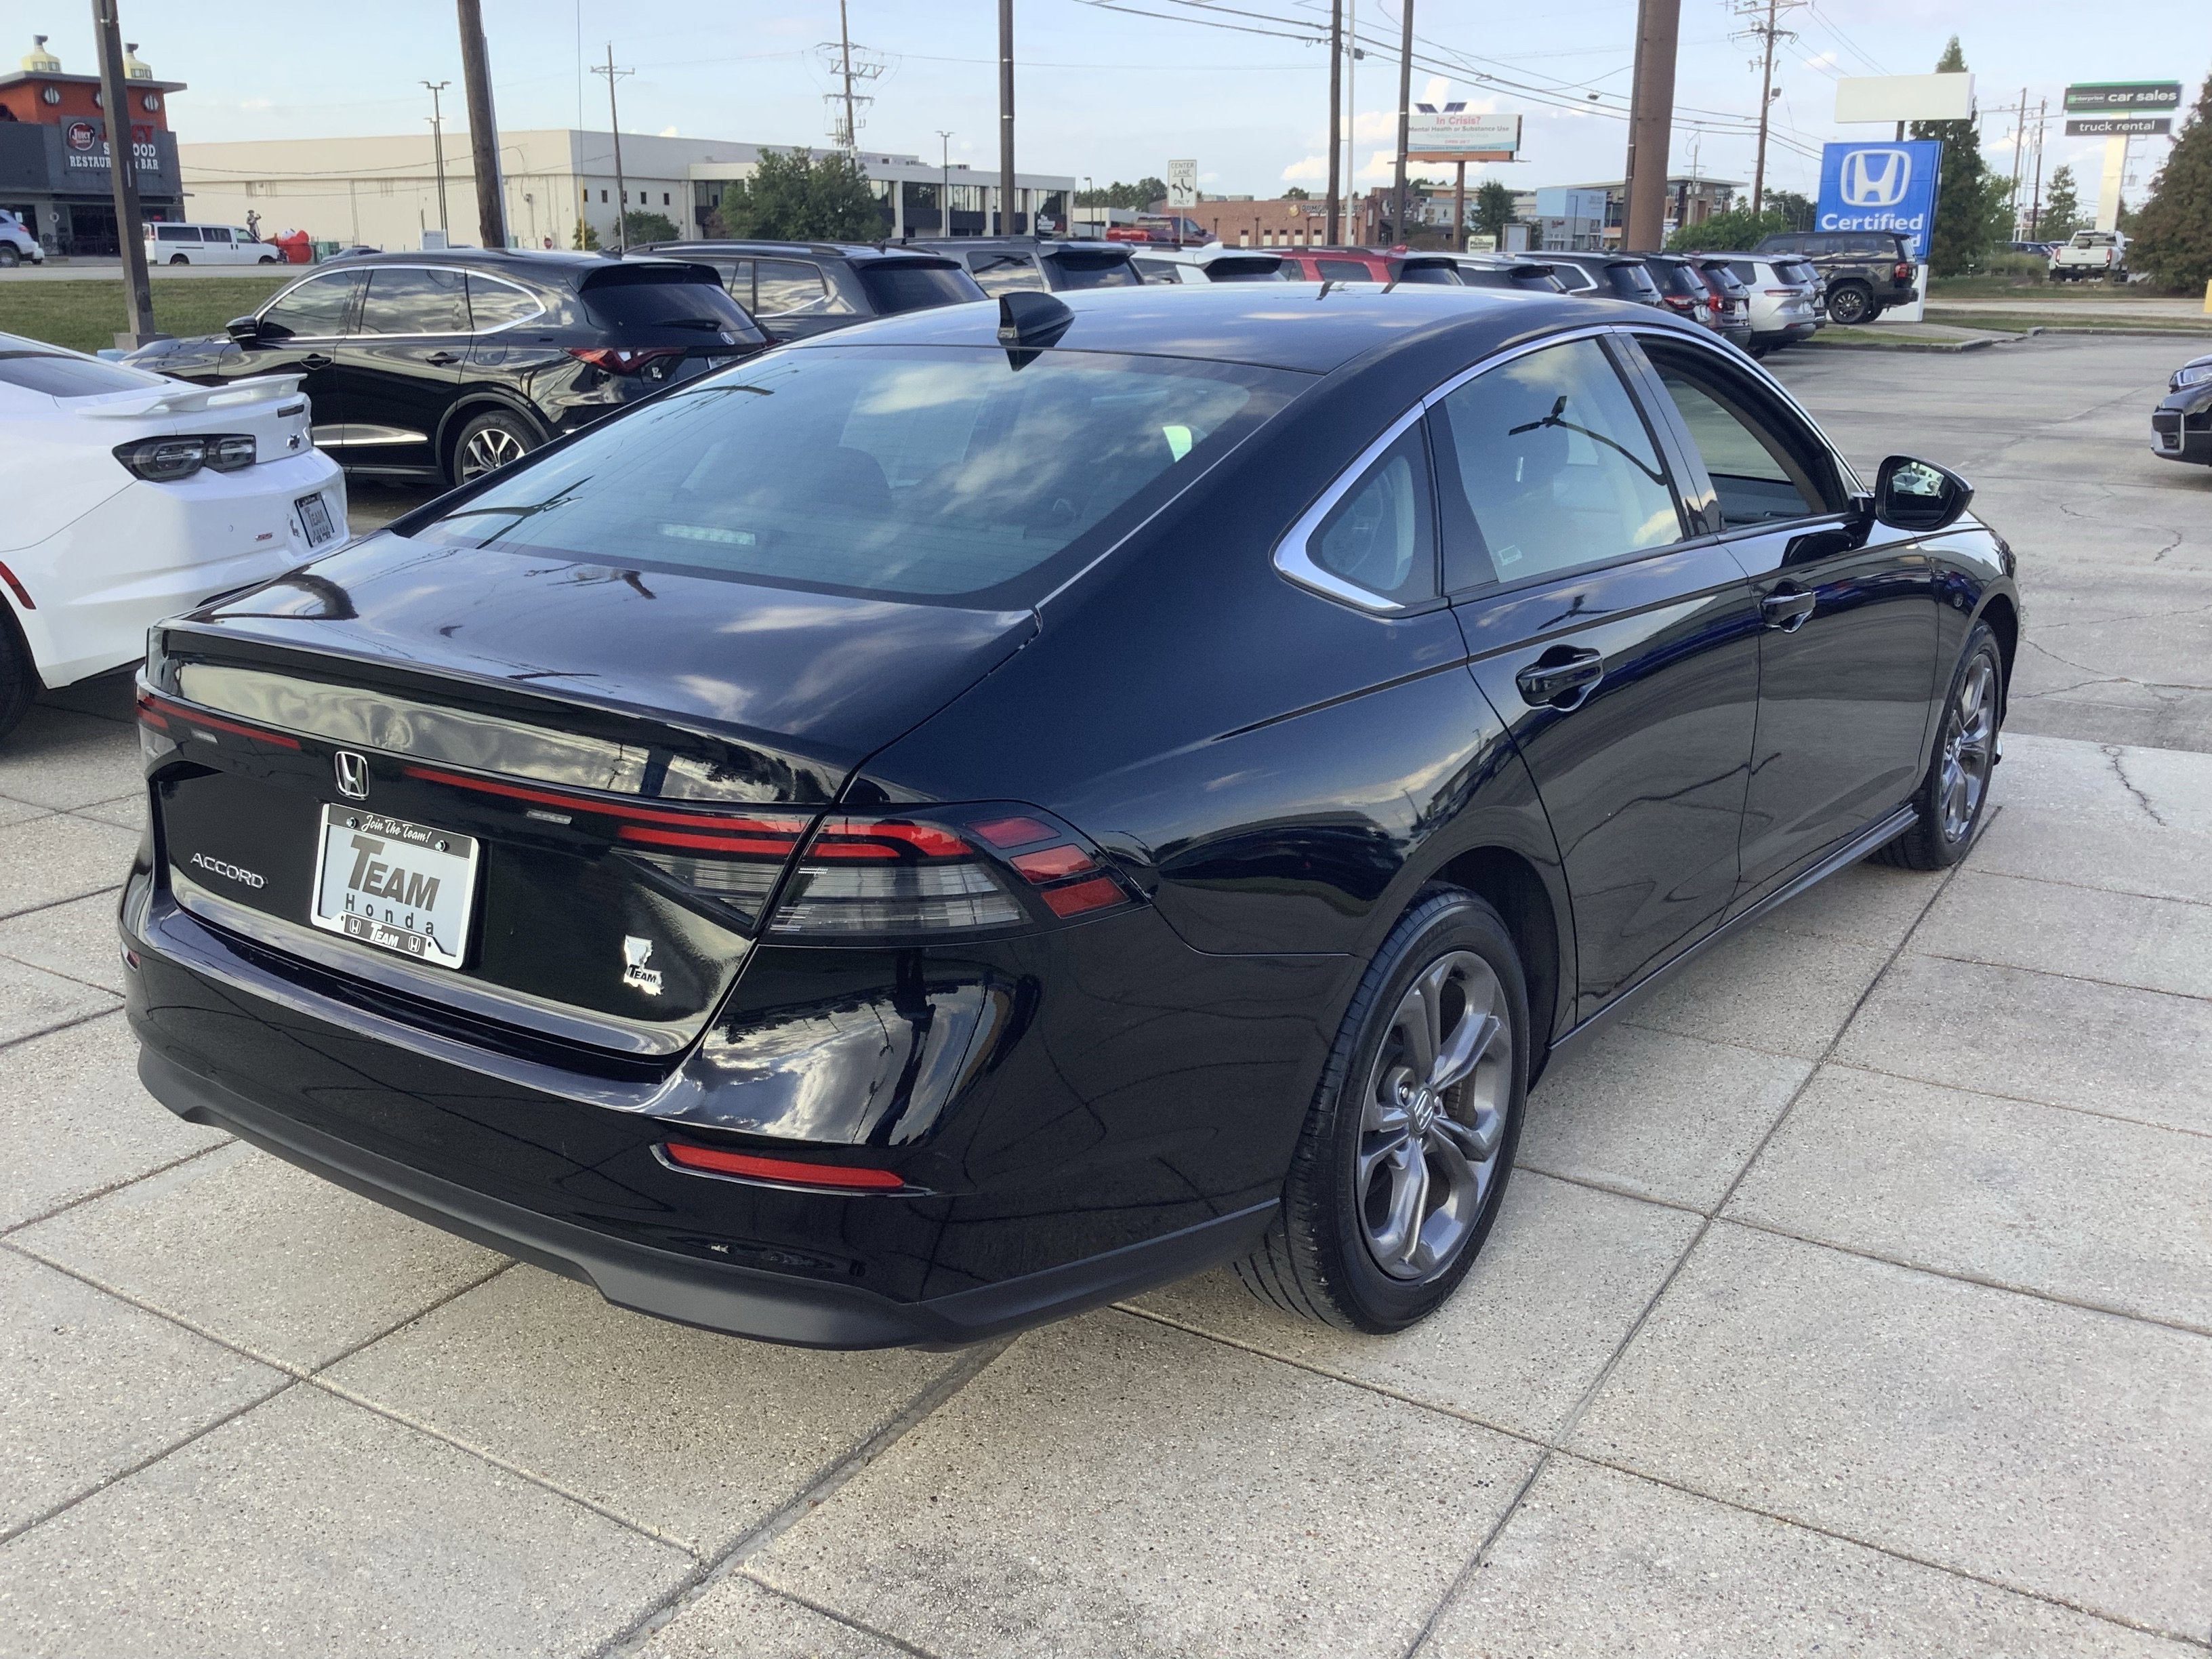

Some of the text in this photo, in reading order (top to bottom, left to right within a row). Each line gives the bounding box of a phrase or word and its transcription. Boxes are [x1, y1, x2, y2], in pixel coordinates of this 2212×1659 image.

[2108, 93, 2133, 102] car
[2136, 89, 2177, 101] sales
[1436, 116, 1481, 125] In Crisis?
[2079, 120, 2155, 131] truck rental
[140, 159, 158, 169] BAR
[1821, 213, 1924, 230] Certified
[361, 815, 432, 843] Join The Team!
[190, 853, 264, 889] ACCORD
[345, 893, 434, 936] Honda
